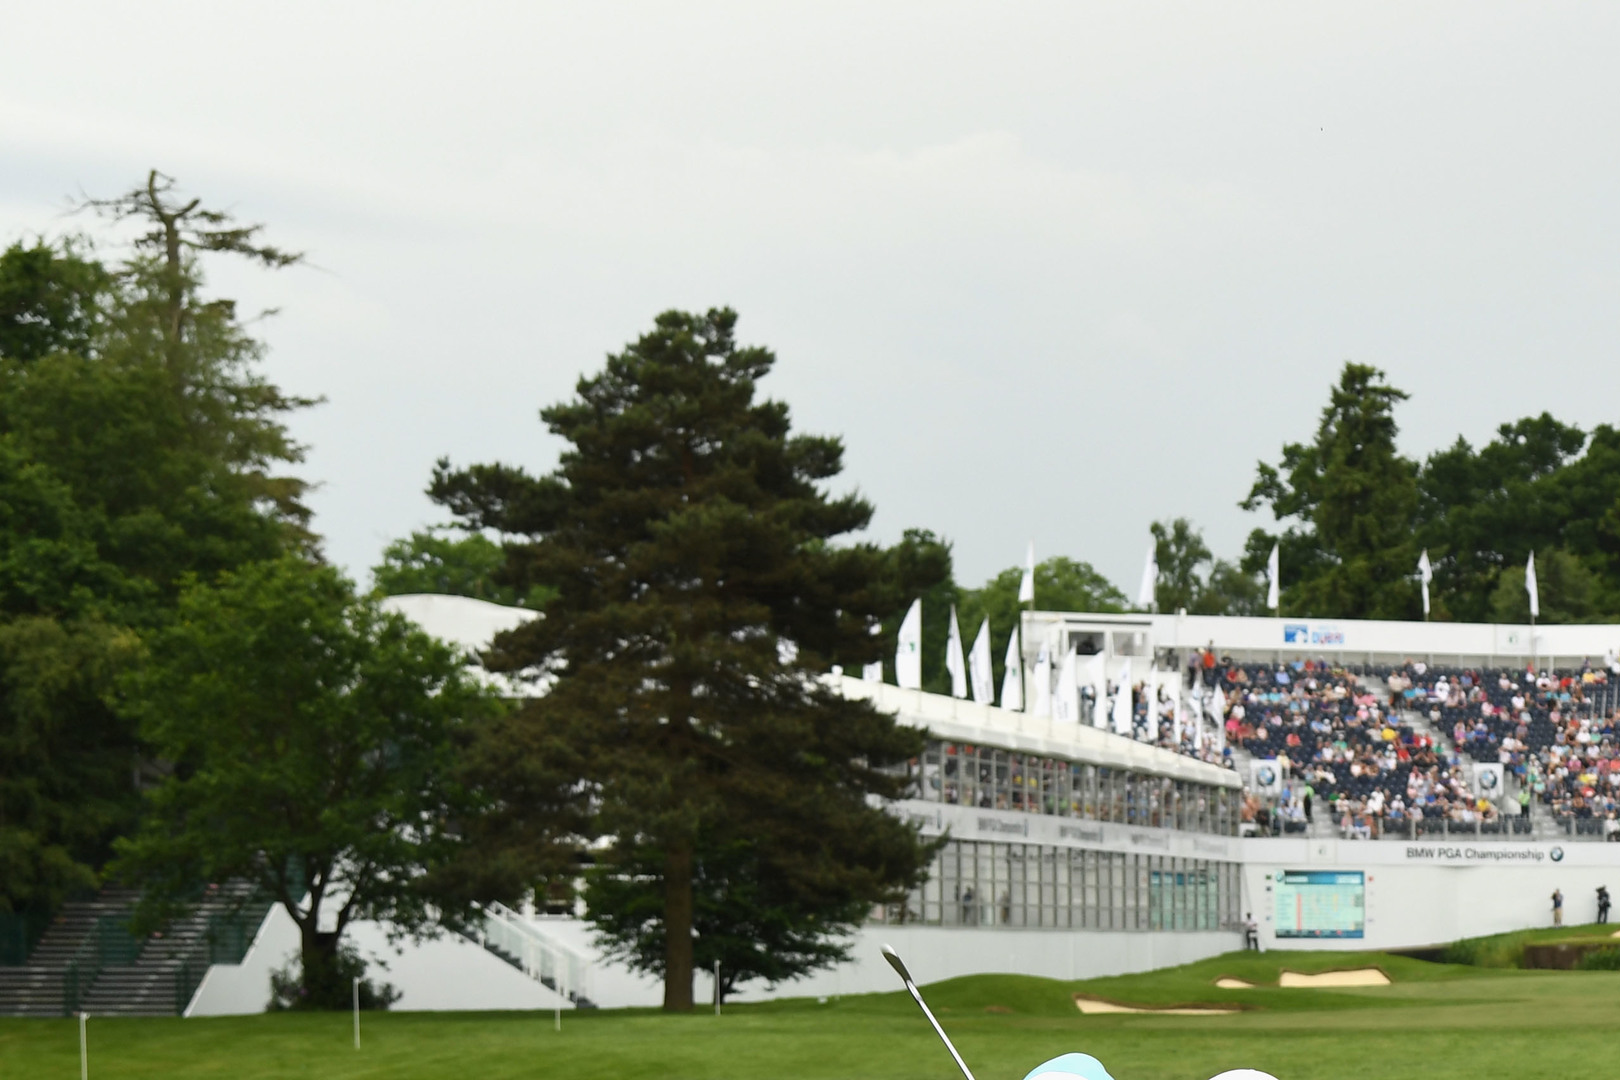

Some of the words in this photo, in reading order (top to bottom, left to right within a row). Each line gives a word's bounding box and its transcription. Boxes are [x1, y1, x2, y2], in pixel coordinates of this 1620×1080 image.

[1406, 847, 1434, 858] BMW
[1438, 847, 1462, 859] PGA
[1465, 847, 1545, 861] Championship
